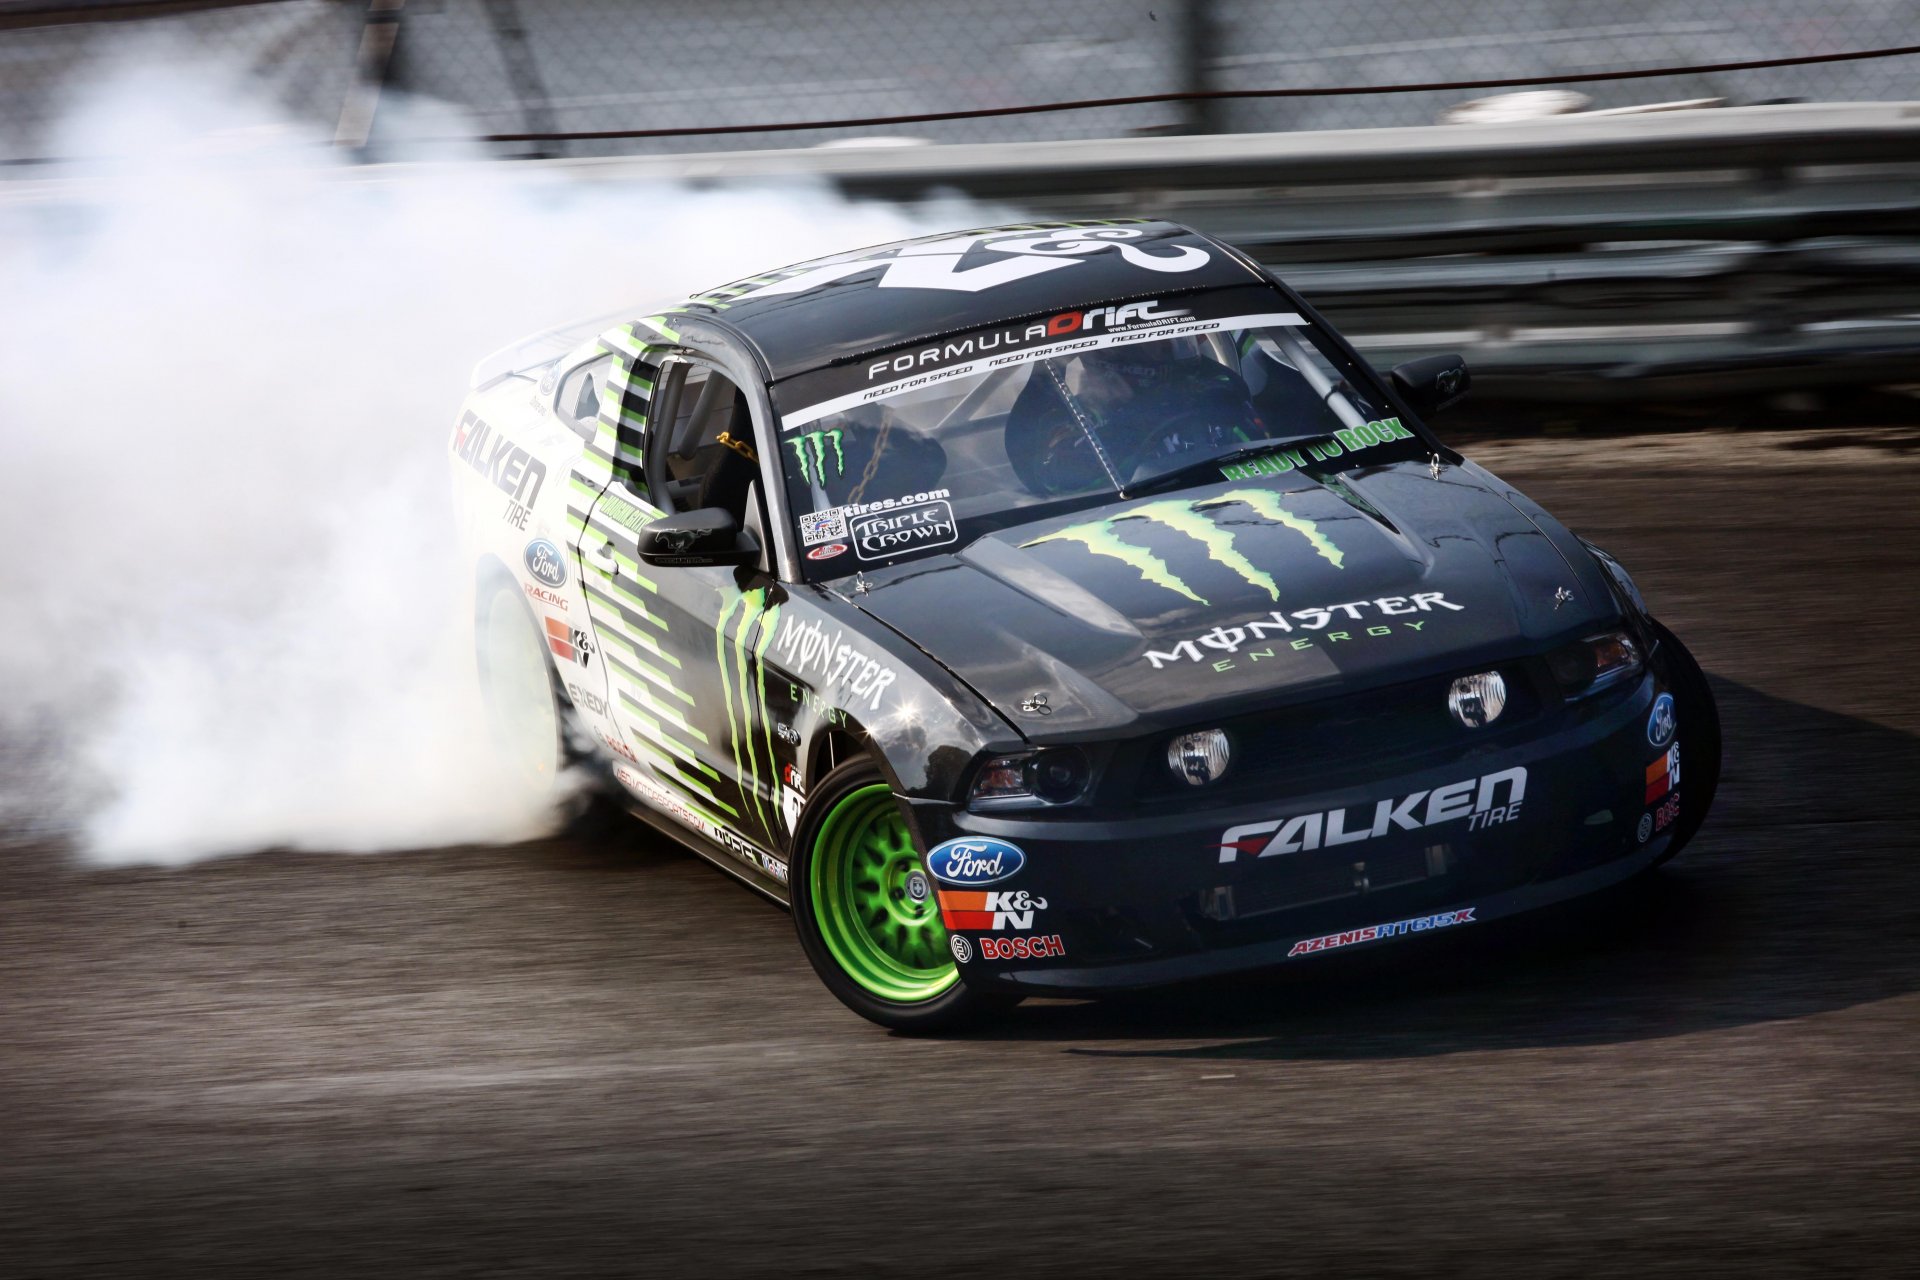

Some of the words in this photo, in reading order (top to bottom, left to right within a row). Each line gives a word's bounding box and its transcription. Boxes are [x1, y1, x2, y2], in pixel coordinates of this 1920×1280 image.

[863, 385, 899, 400] NEED
[900, 377, 927, 390] FOR
[930, 366, 973, 382] SPEED
[988, 354, 1024, 367] NEED
[1026, 347, 1052, 359] FOR
[1055, 340, 1098, 353] SPEED
[1111, 332, 1146, 343] NEED
[1148, 328, 1175, 338] FOR
[1177, 323, 1220, 334] SPEED
[452, 408, 547, 511] FALKEN
[1219, 446, 1308, 481] READY
[1306, 438, 1343, 462] TO
[1333, 417, 1415, 451] ROCK
[502, 498, 532, 532] TIRE
[855, 508, 939, 538] TRIPLE
[861, 520, 953, 552] CROWN
[532, 544, 560, 581] Ford
[523, 582, 569, 612] RACING
[1212, 620, 1426, 673] ENERGY
[568, 682, 608, 720] EXEDY
[790, 683, 847, 729] ENERGY
[1655, 703, 1674, 742] Ford
[1217, 766, 1528, 864] FALKEN
[1467, 801, 1523, 832] TIRE
[945, 843, 1004, 878] Ford
[979, 934, 1066, 960] BOSCH
